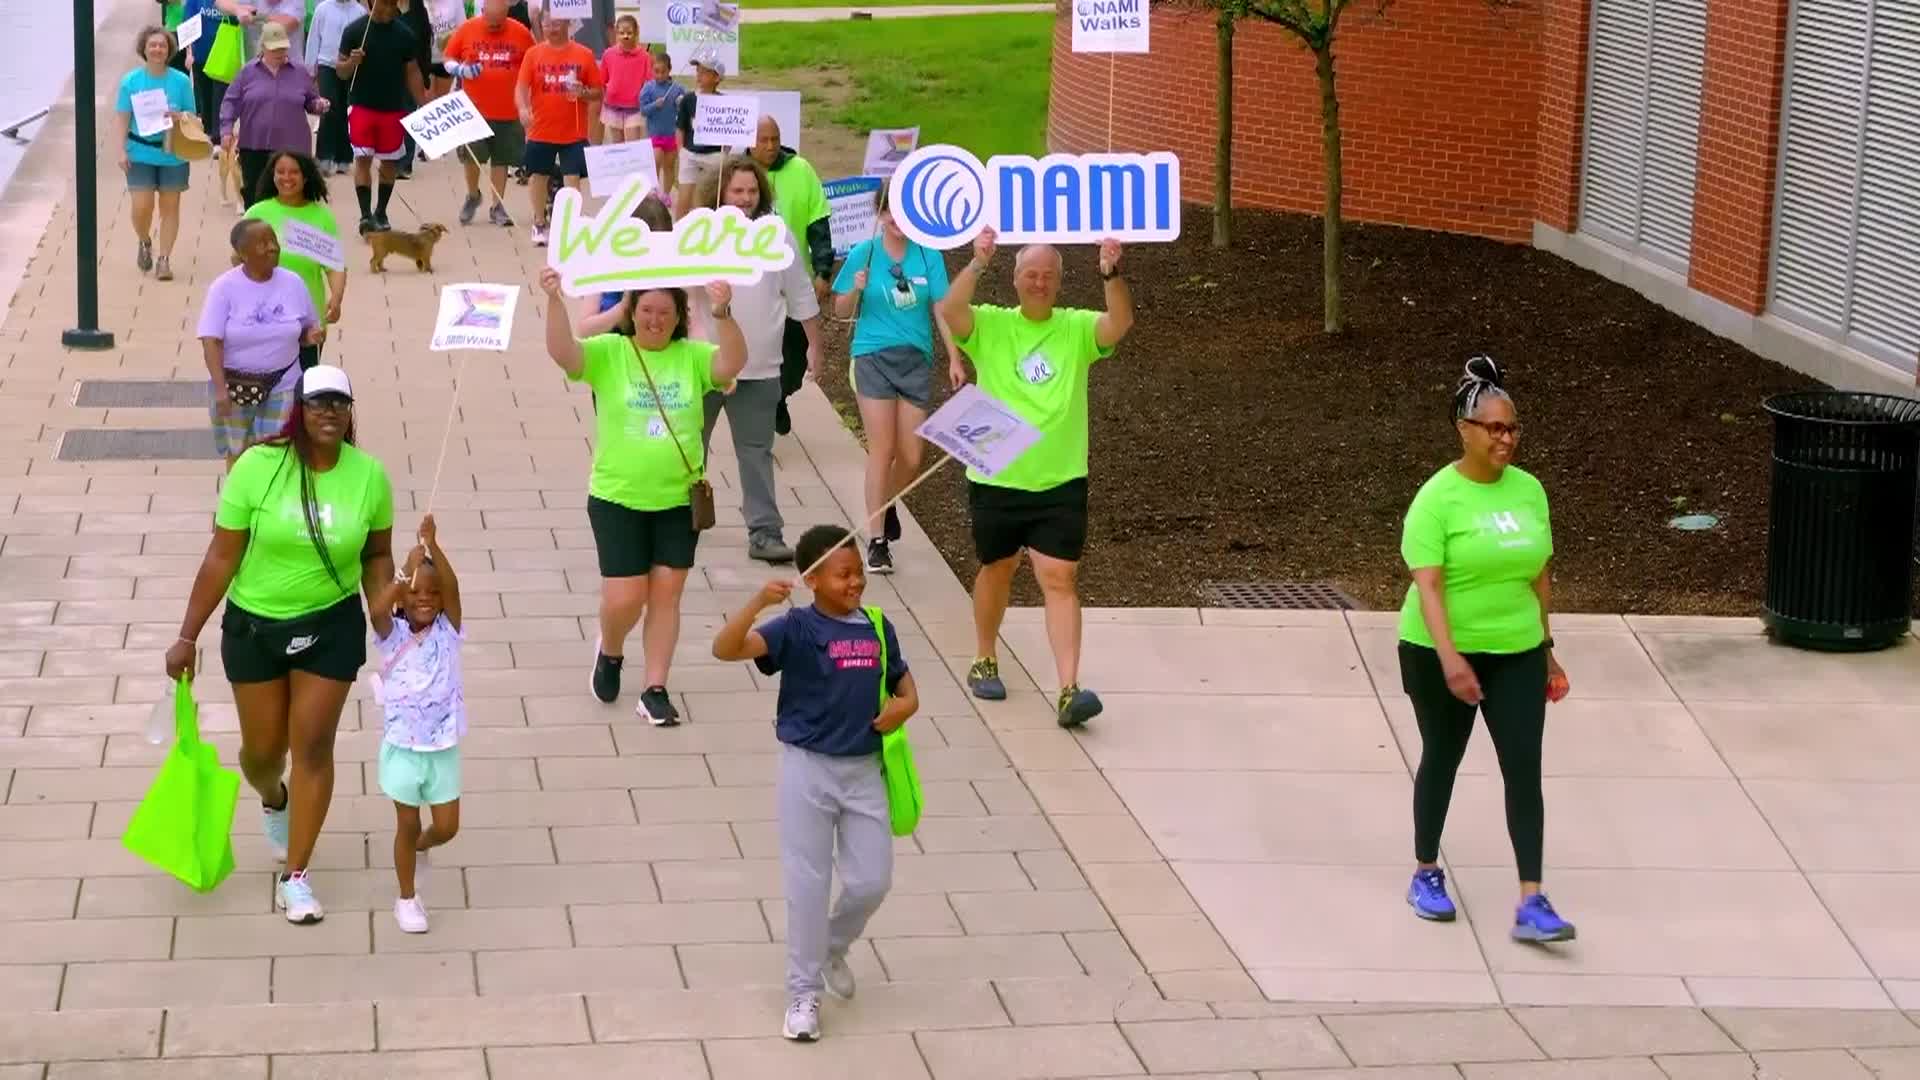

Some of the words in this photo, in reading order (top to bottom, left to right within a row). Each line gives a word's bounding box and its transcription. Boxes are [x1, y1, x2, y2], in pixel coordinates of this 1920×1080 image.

[1093, 0, 1139, 16] NAMI
[1080, 16, 1141, 32] Walks
[420, 111, 474, 141] Walks
[423, 98, 465, 126] NAMI
[999, 163, 1170, 232] NAMI
[560, 179, 650, 263] We
[679, 212, 786, 260] are
